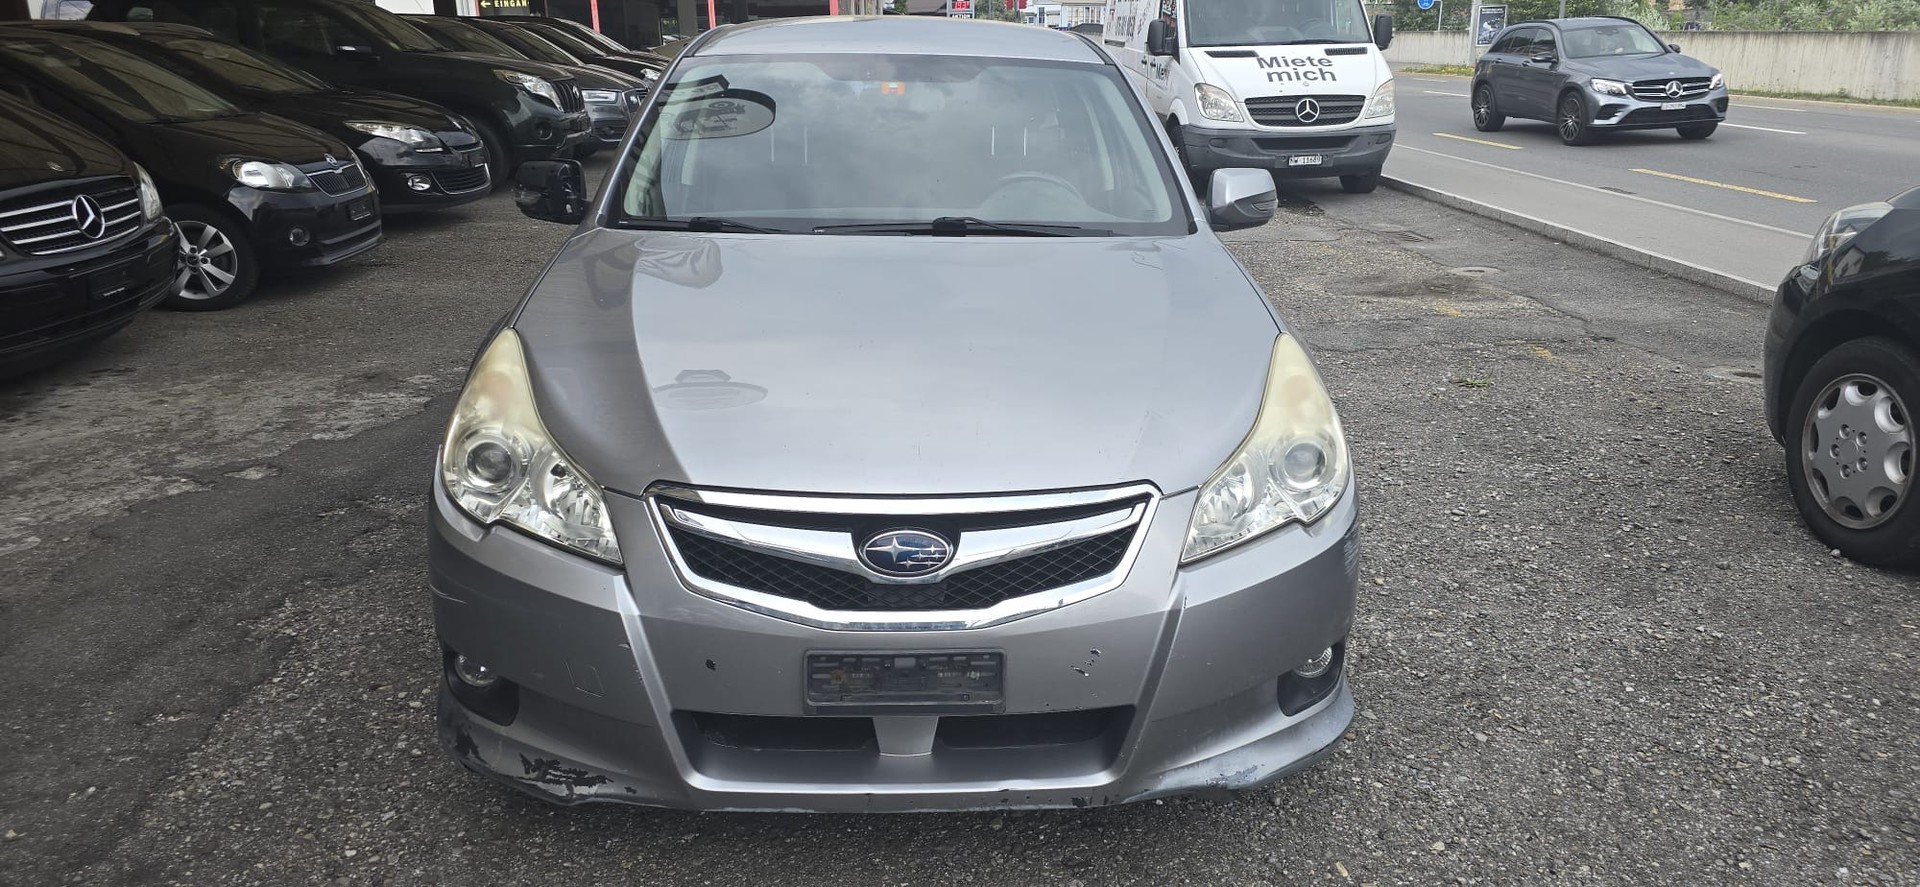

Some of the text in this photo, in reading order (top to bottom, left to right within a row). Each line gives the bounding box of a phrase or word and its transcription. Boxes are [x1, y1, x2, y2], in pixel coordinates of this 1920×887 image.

[494, 0, 530, 8] EINGAN
[1256, 56, 1333, 69] Miete
[1266, 67, 1337, 82] mich
